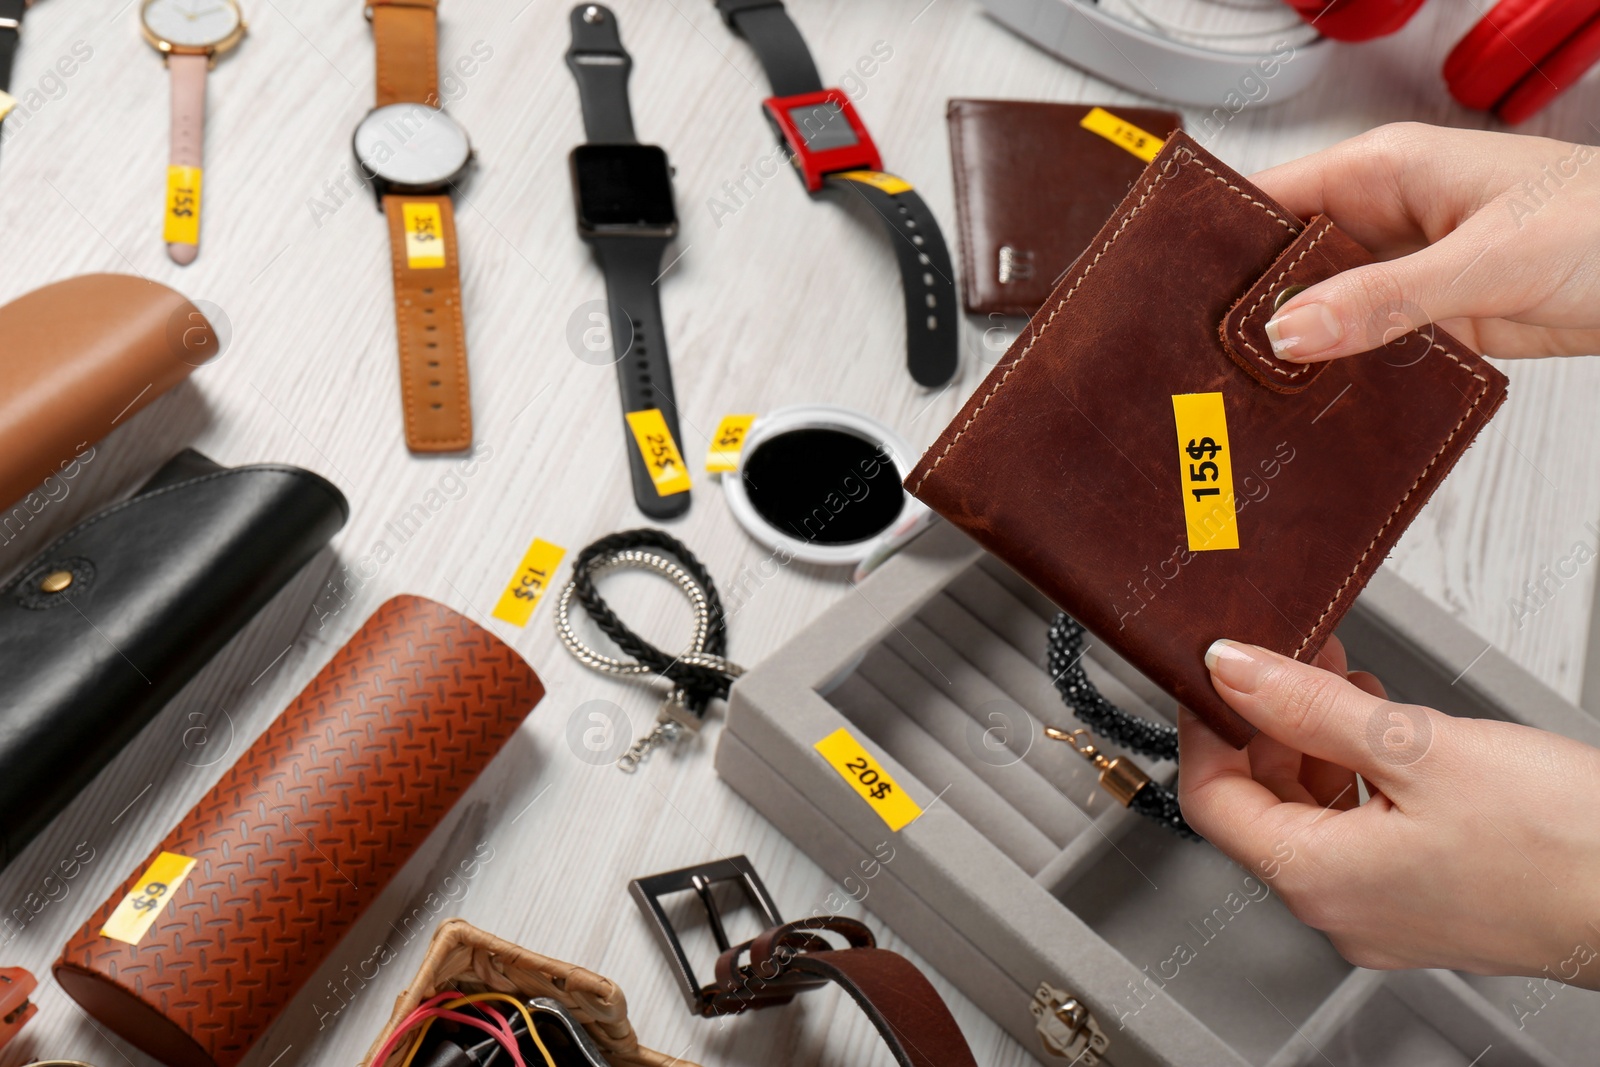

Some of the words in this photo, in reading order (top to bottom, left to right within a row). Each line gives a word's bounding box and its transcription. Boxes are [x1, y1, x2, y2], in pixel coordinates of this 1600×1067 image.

[173, 187, 195, 217] 15$
[646, 434, 676, 470] 25$
[718, 426, 744, 446] 5$
[1185, 437, 1222, 502] 15$
[511, 567, 547, 602] 15$
[845, 757, 892, 800] 20$
[131, 882, 168, 912] 6$
